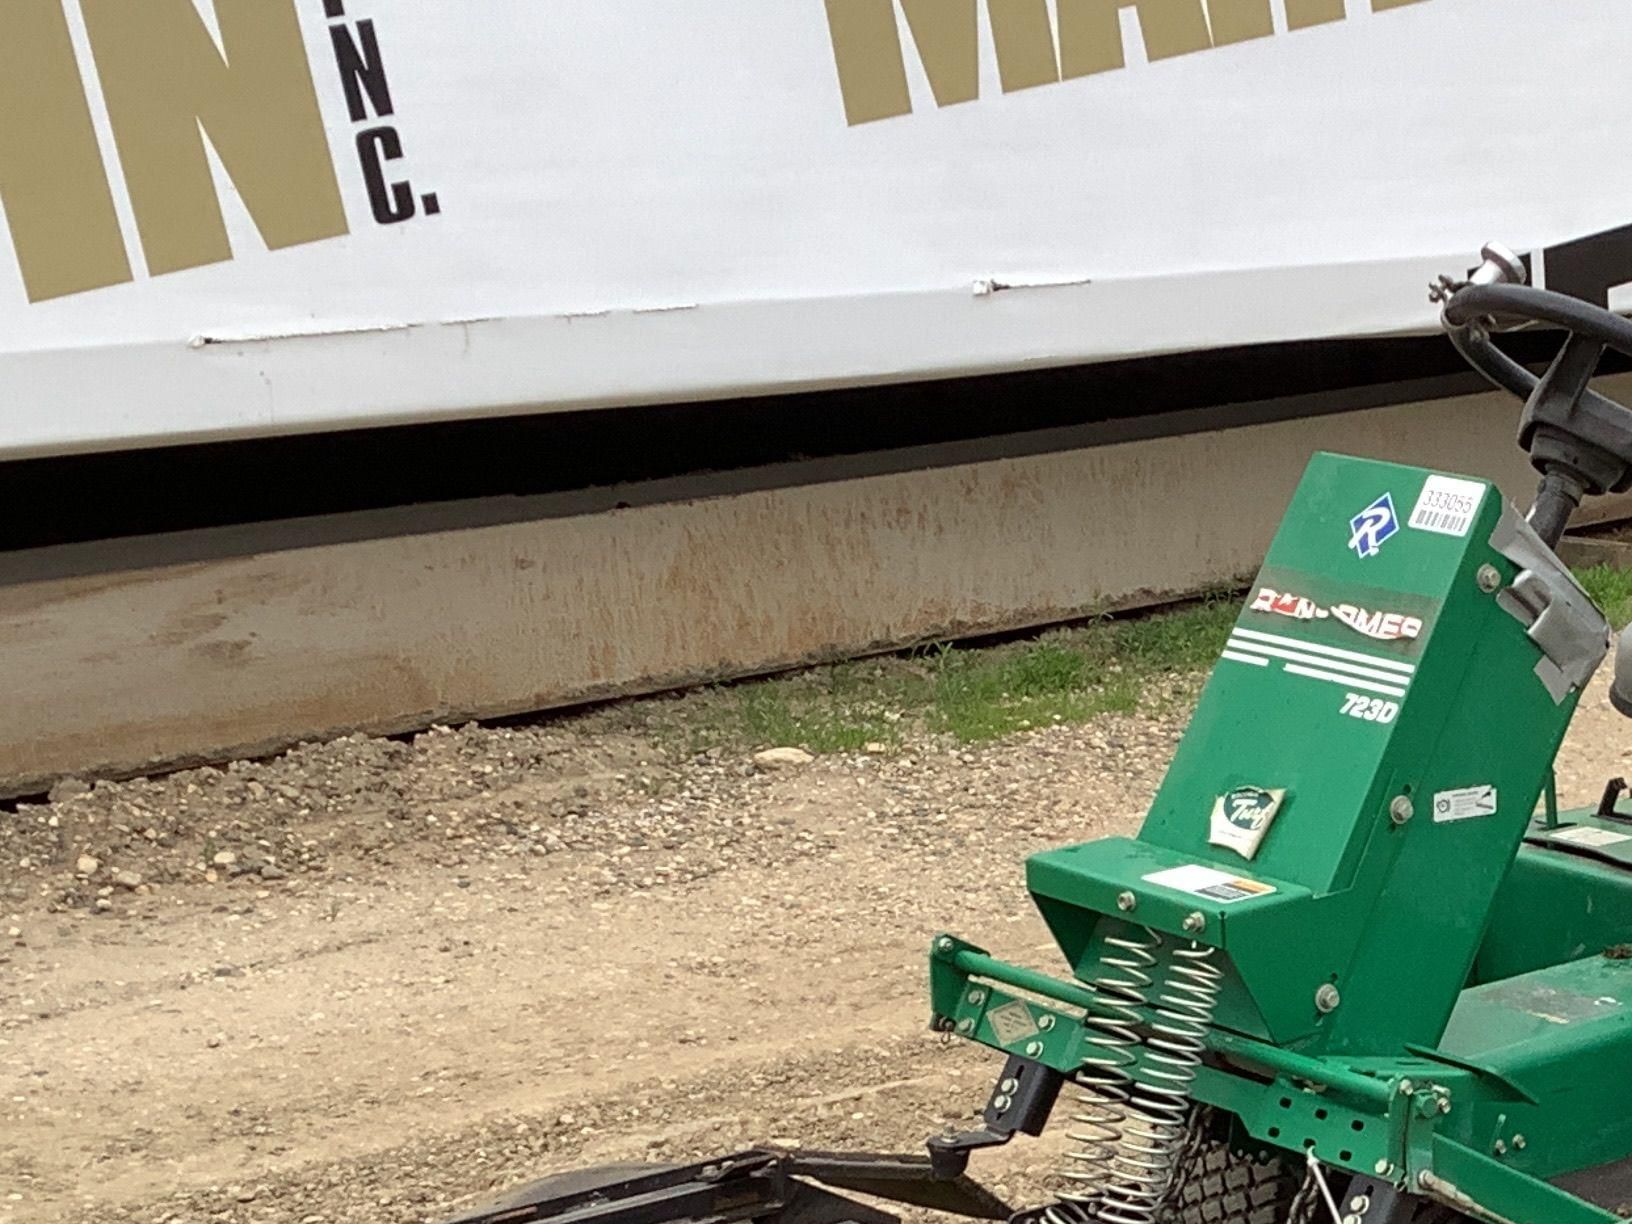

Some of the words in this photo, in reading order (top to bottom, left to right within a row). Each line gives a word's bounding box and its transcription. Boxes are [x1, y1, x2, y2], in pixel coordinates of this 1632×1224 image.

[325, 0, 441, 226] NC.
[1250, 588, 1422, 640] RNOMES
[1339, 692, 1399, 724] 723D
